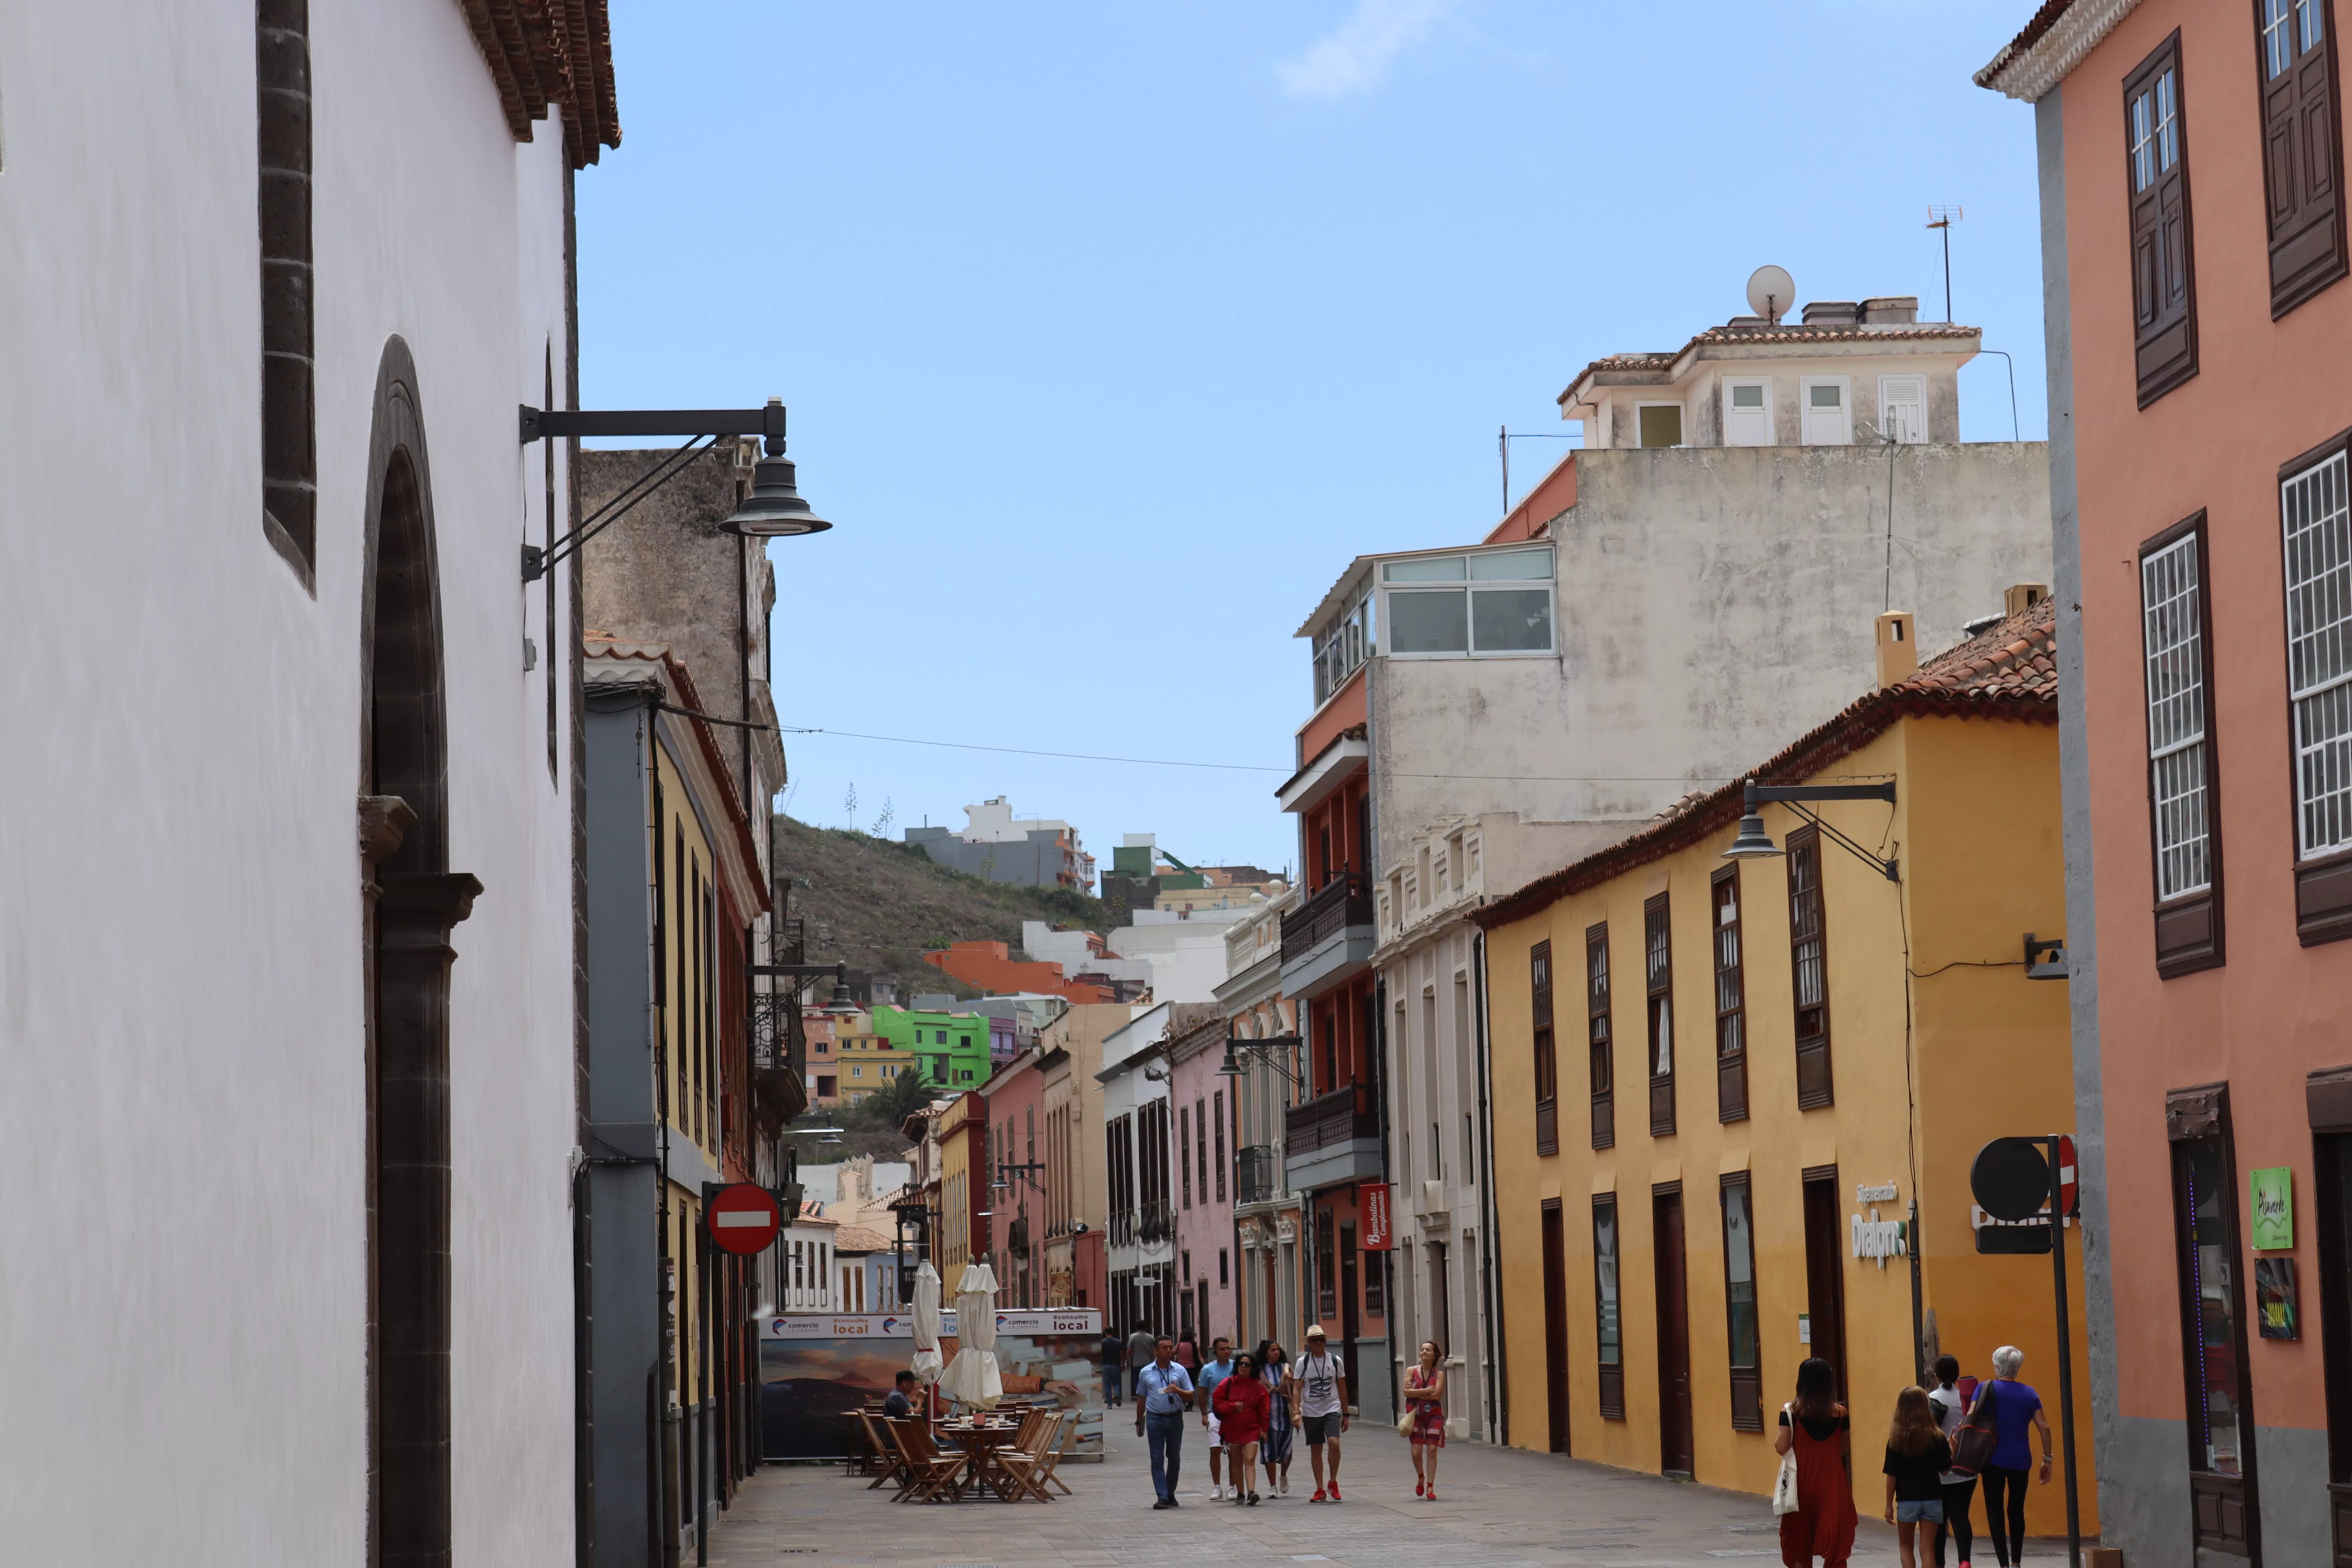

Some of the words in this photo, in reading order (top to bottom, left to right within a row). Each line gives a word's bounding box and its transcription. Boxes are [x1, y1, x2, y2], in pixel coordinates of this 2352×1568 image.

[1857, 1180, 1897, 1207] Supermercado
[2258, 1186, 2285, 1216] Pisaverde
[1367, 1192, 1380, 1245] Bambalinas
[1378, 1191, 1388, 1236] Complementos
[1851, 1209, 1906, 1270] Dialprix
[834, 1324, 869, 1334] local
[1054, 1320, 1088, 1330] local
